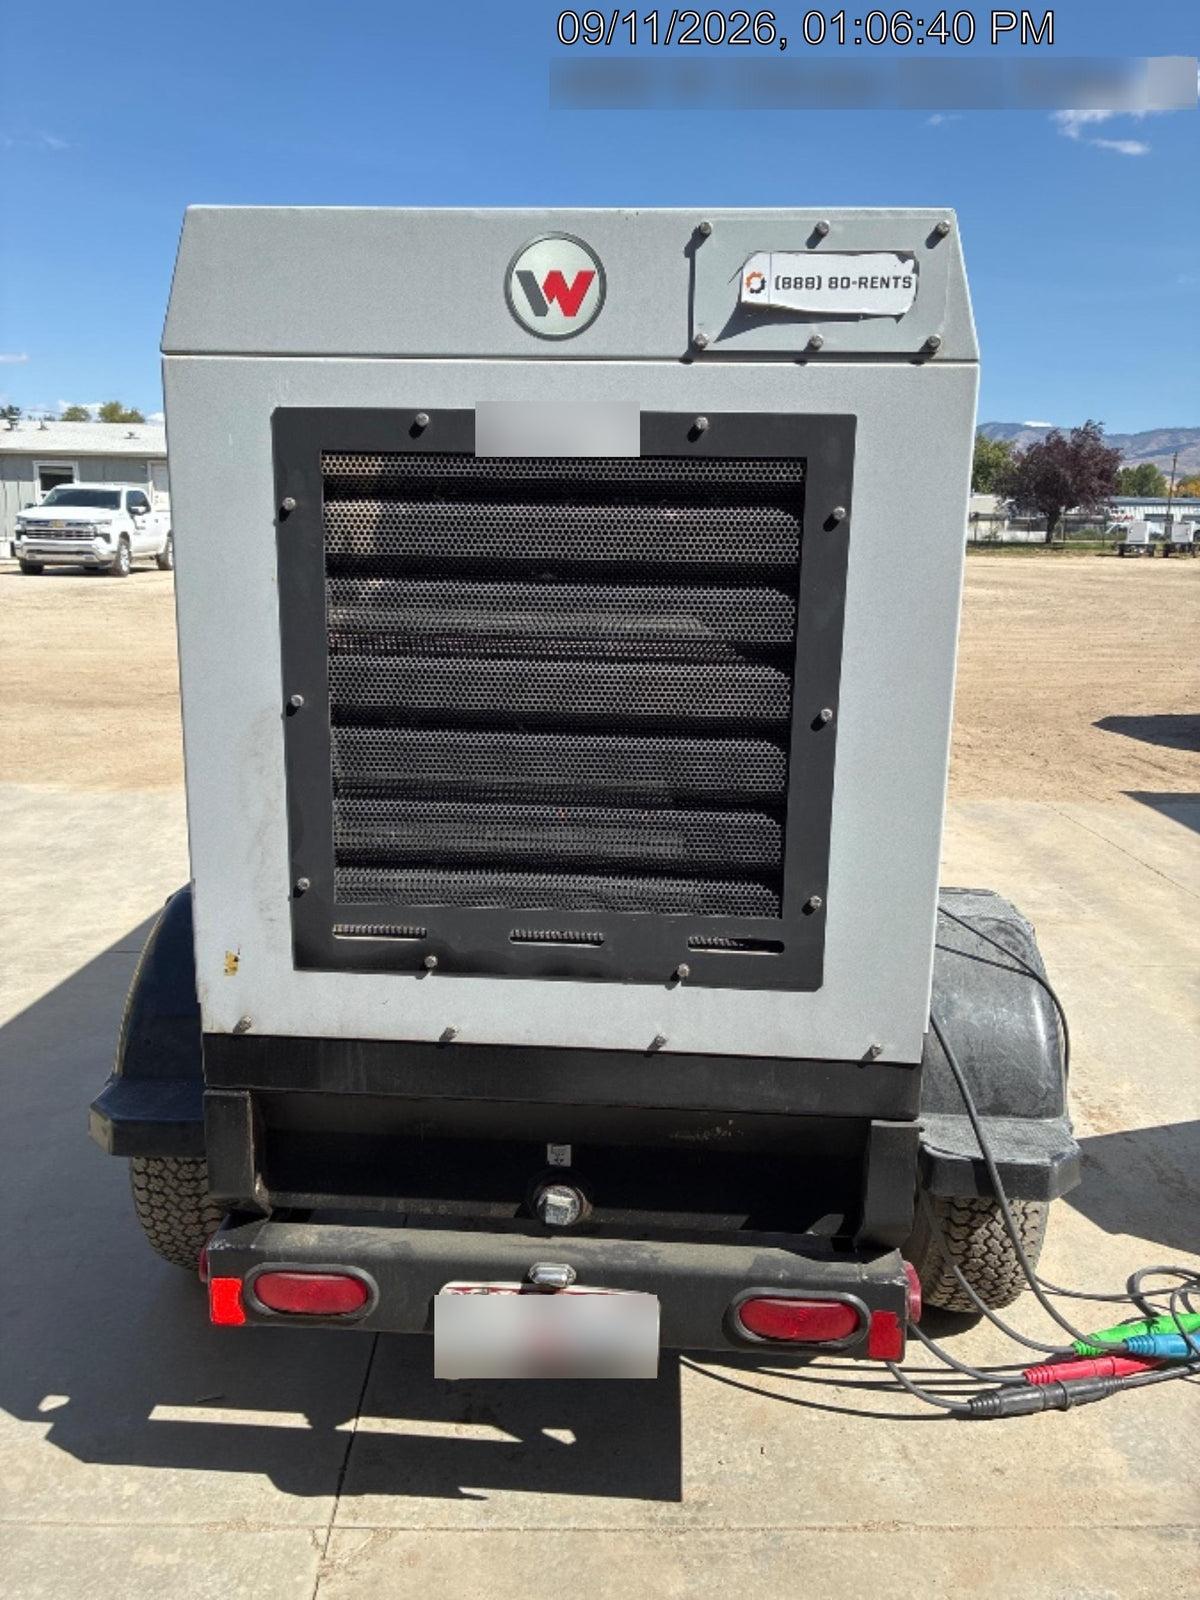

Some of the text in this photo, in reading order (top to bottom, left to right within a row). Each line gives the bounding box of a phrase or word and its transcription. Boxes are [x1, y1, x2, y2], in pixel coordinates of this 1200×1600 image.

[515, 270, 596, 317] W
[774, 275, 912, 290] (888) 80-RENTS
